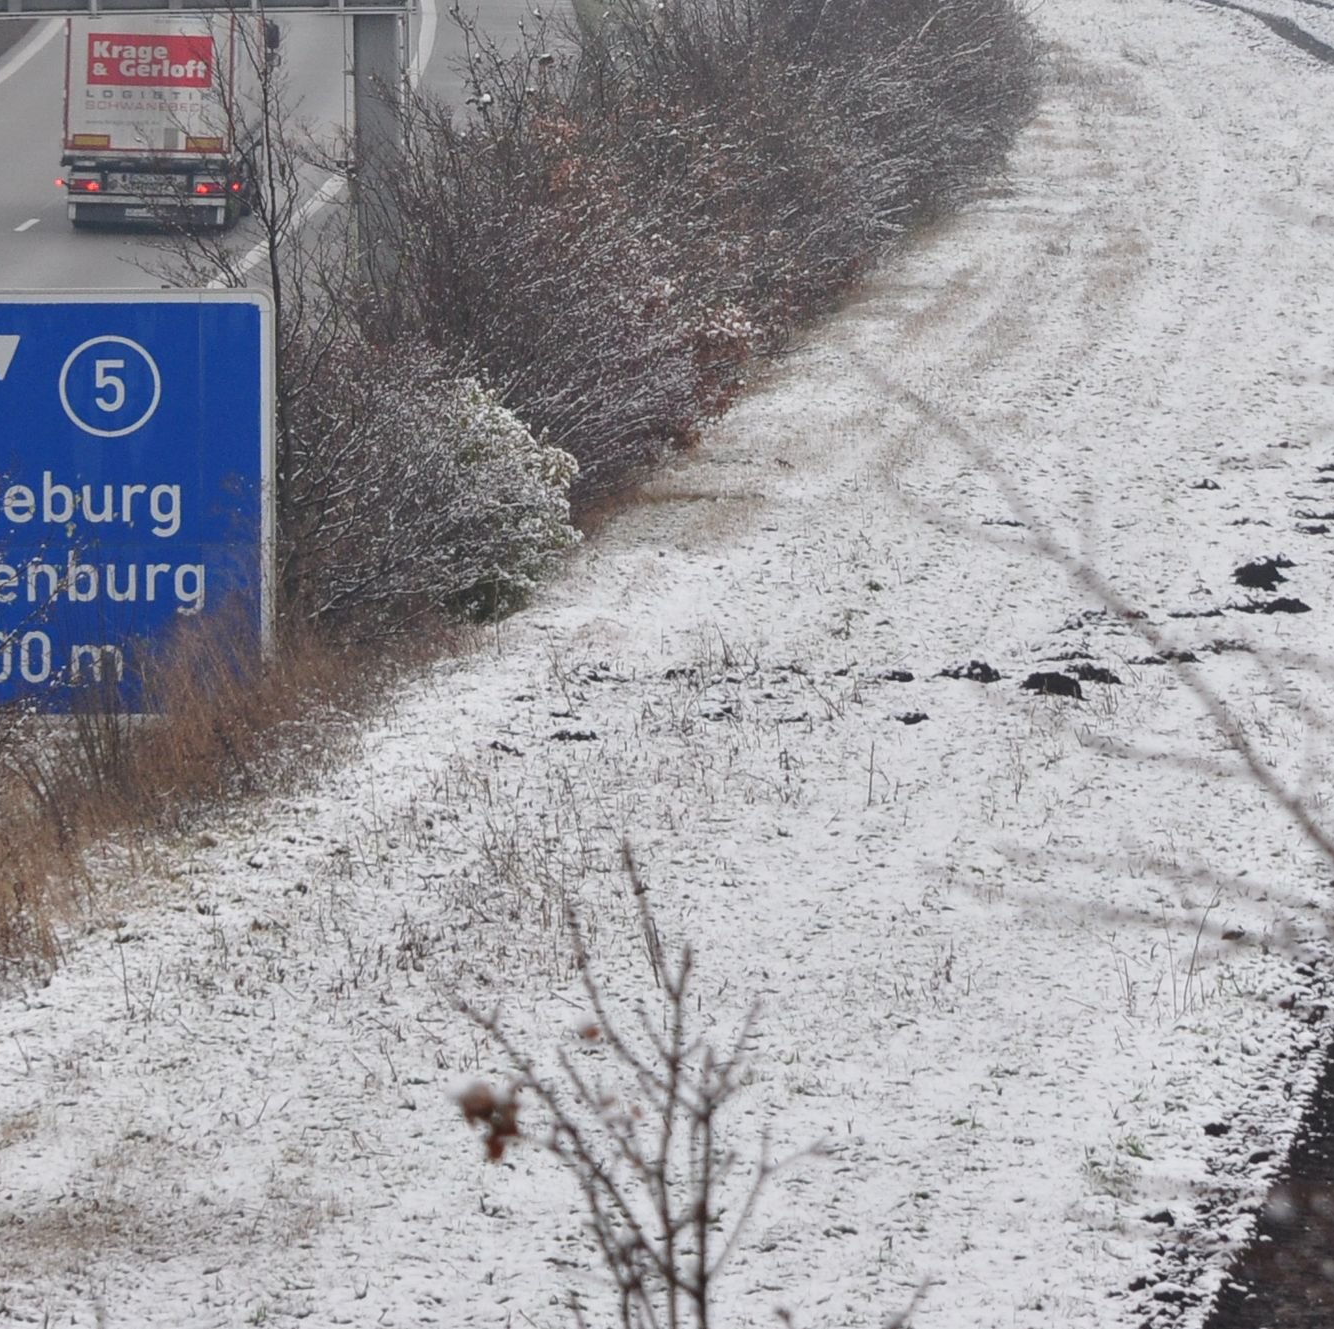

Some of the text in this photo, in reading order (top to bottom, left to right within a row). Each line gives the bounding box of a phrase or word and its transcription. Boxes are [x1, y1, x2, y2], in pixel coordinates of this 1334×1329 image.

[93, 40, 168, 64] Krage
[93, 59, 208, 78] & Gerloft
[85, 100, 212, 113] SCHWANEBECK
[94, 359, 126, 413] 5
[70, 642, 125, 683] m
